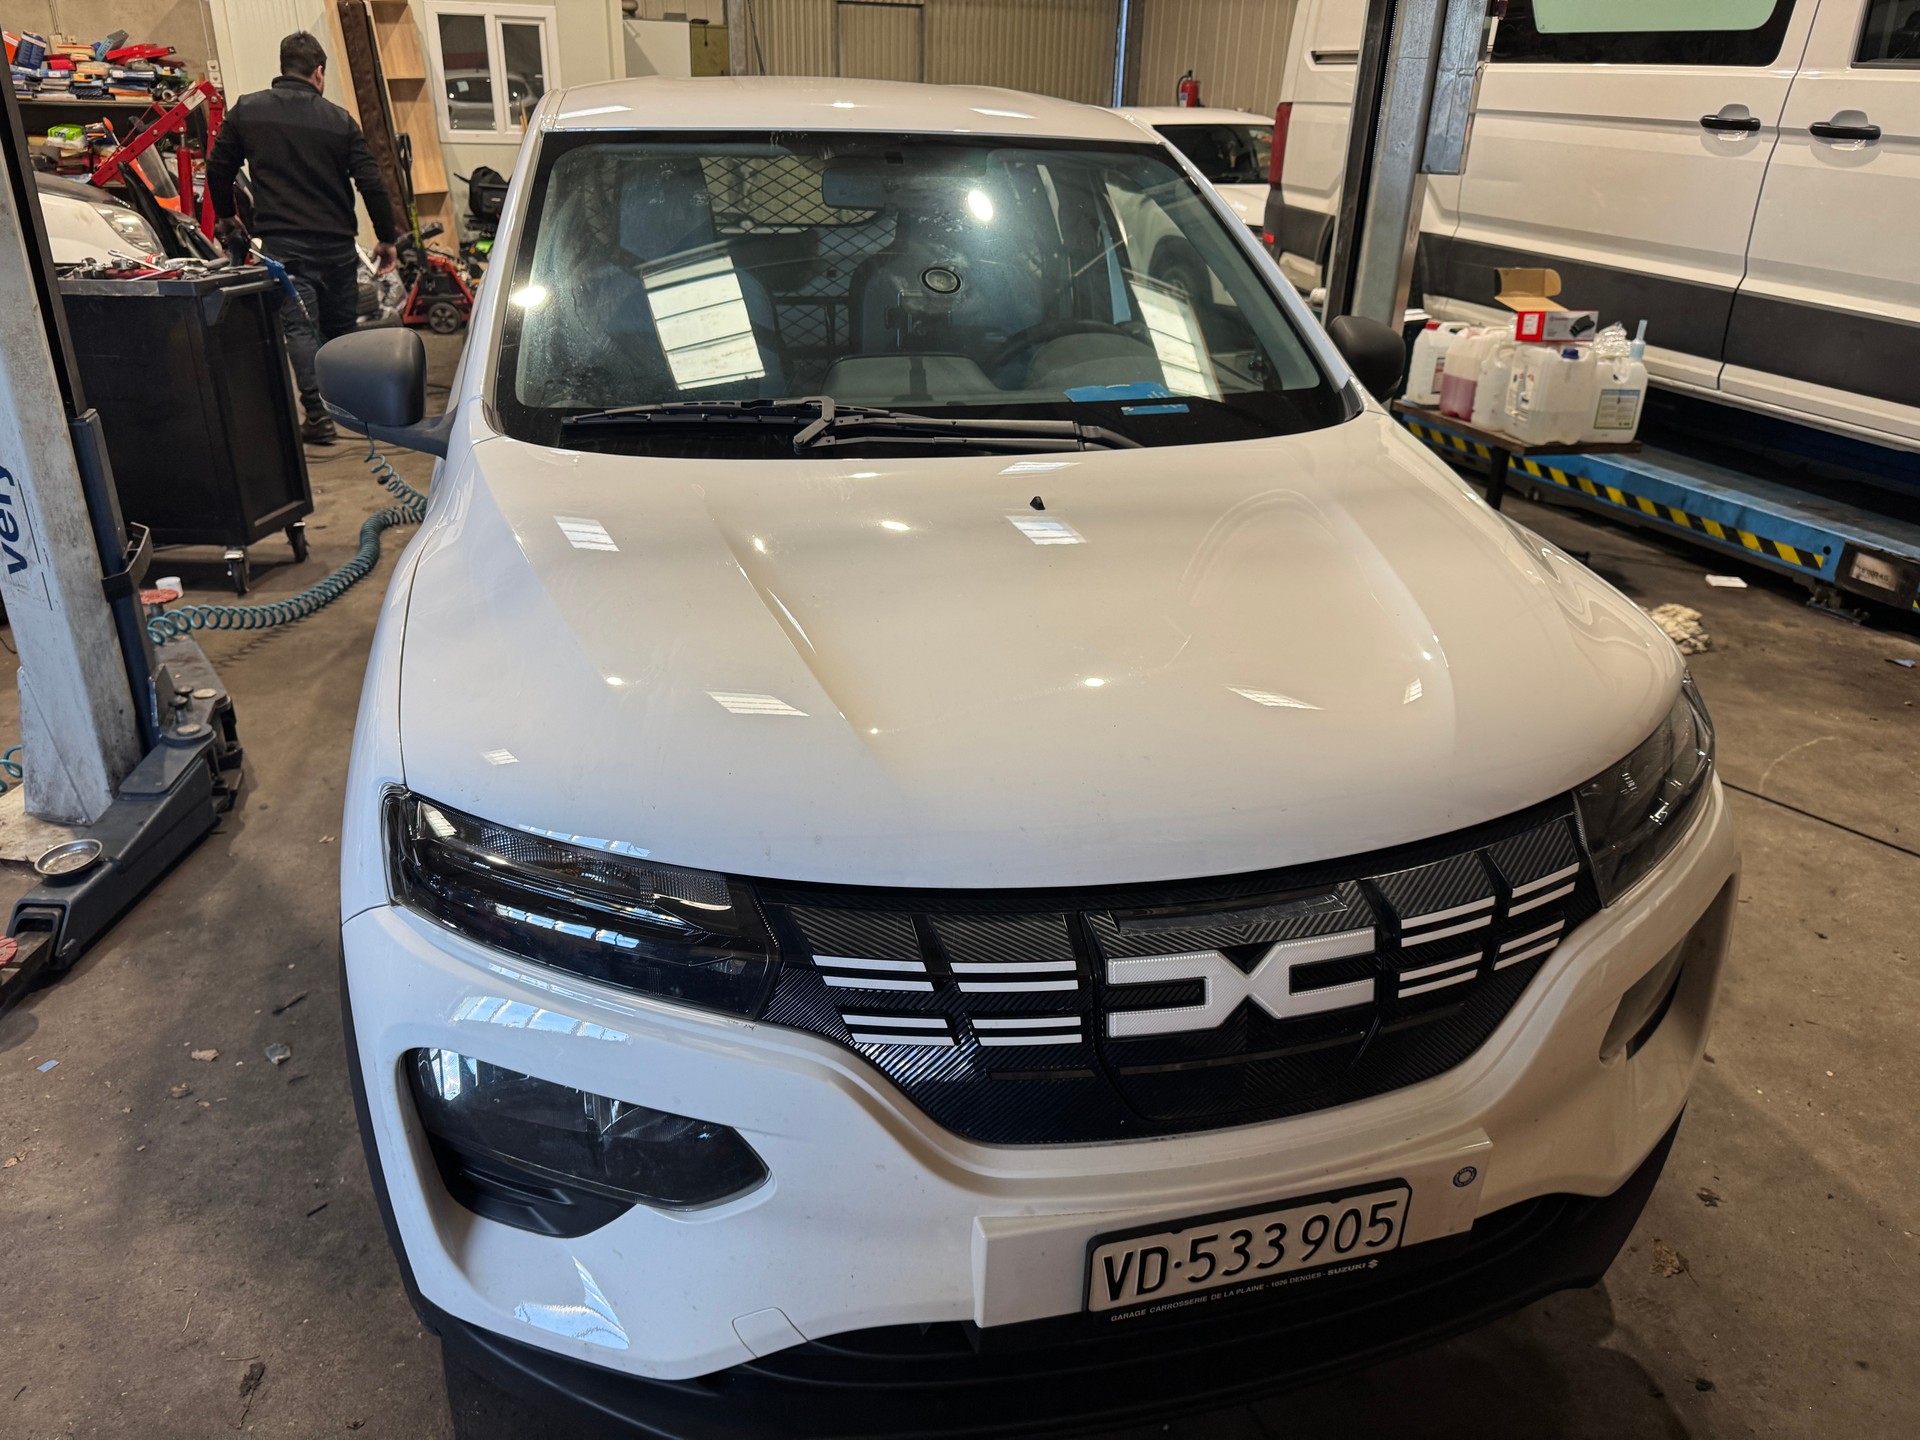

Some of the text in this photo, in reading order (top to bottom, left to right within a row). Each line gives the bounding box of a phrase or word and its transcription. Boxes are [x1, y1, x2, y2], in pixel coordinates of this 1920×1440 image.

[1110, 1308, 1147, 1322] GARAGE
[1149, 1295, 1208, 1314] CARROSSERIE
[1210, 1292, 1222, 1300] DE
[1223, 1290, 1235, 1298] LA
[1236, 1283, 1264, 1295] PLAINE
[1289, 1271, 1322, 1284] DENGES
[1327, 1262, 1366, 1276] SUZUKI
